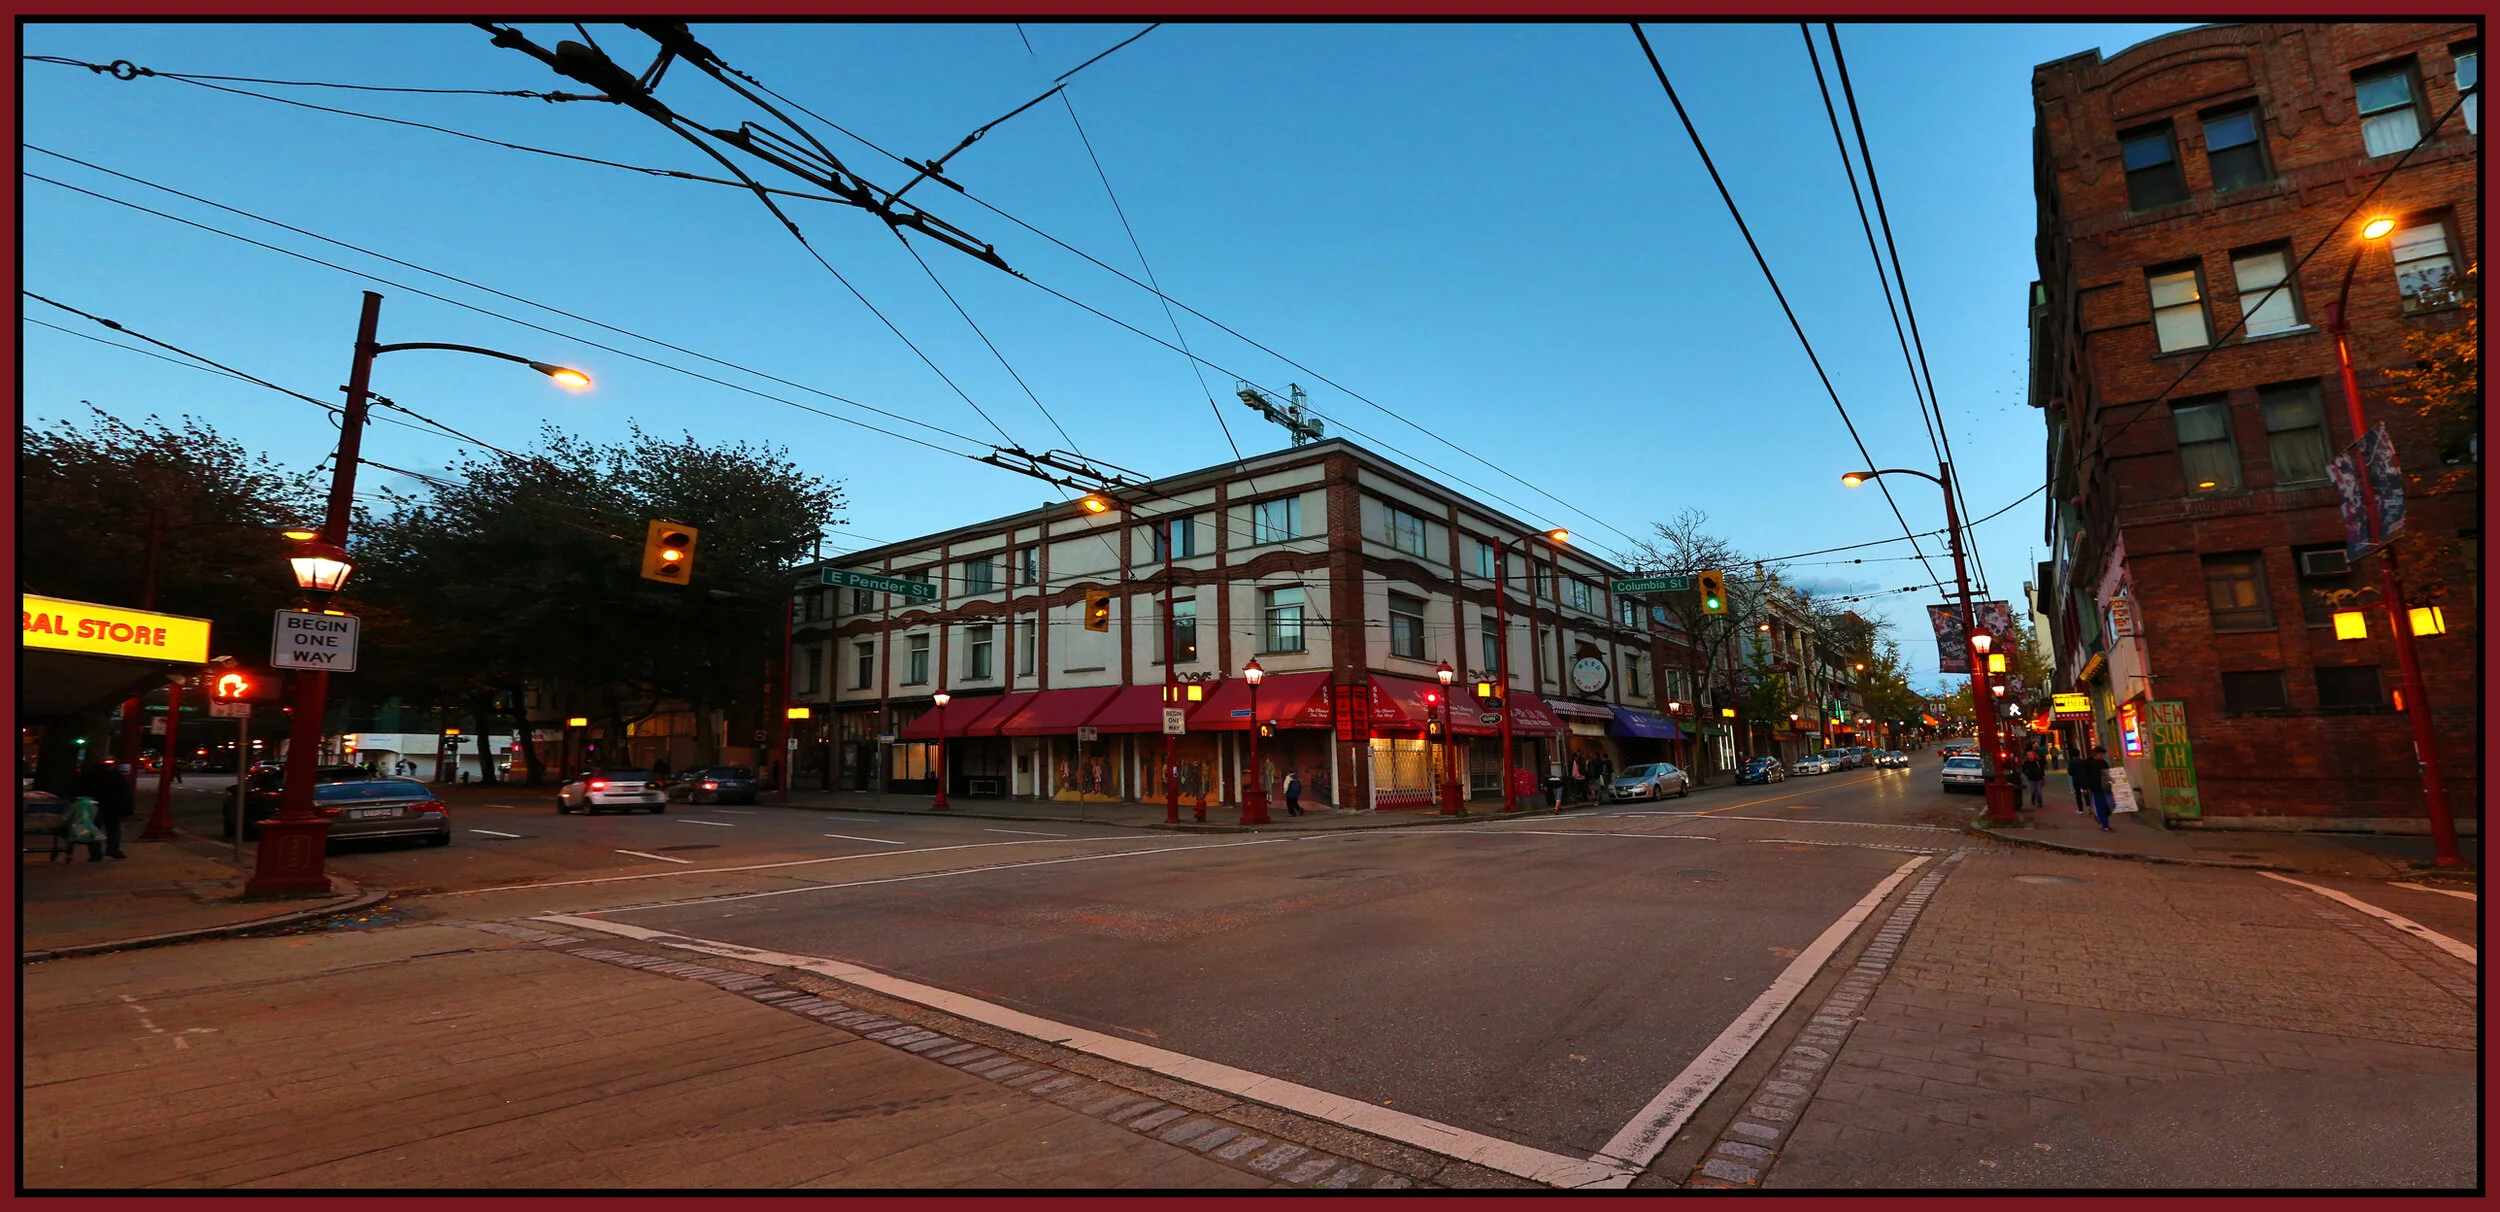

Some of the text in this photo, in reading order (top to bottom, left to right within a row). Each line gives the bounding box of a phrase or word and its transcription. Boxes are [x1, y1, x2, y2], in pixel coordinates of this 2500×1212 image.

[831, 571, 929, 596] E Pender St
[1617, 579, 1682, 592] Columbia St
[77, 619, 167, 647] STORE
[287, 617, 348, 633] BEGIN
[294, 633, 339, 648] ONE
[293, 650, 337, 663] WAY
[2150, 704, 2185, 724] NEW
[2155, 725, 2189, 745] SUN
[2164, 747, 2187, 767] AH
[2160, 768, 2195, 788] HOTEL
